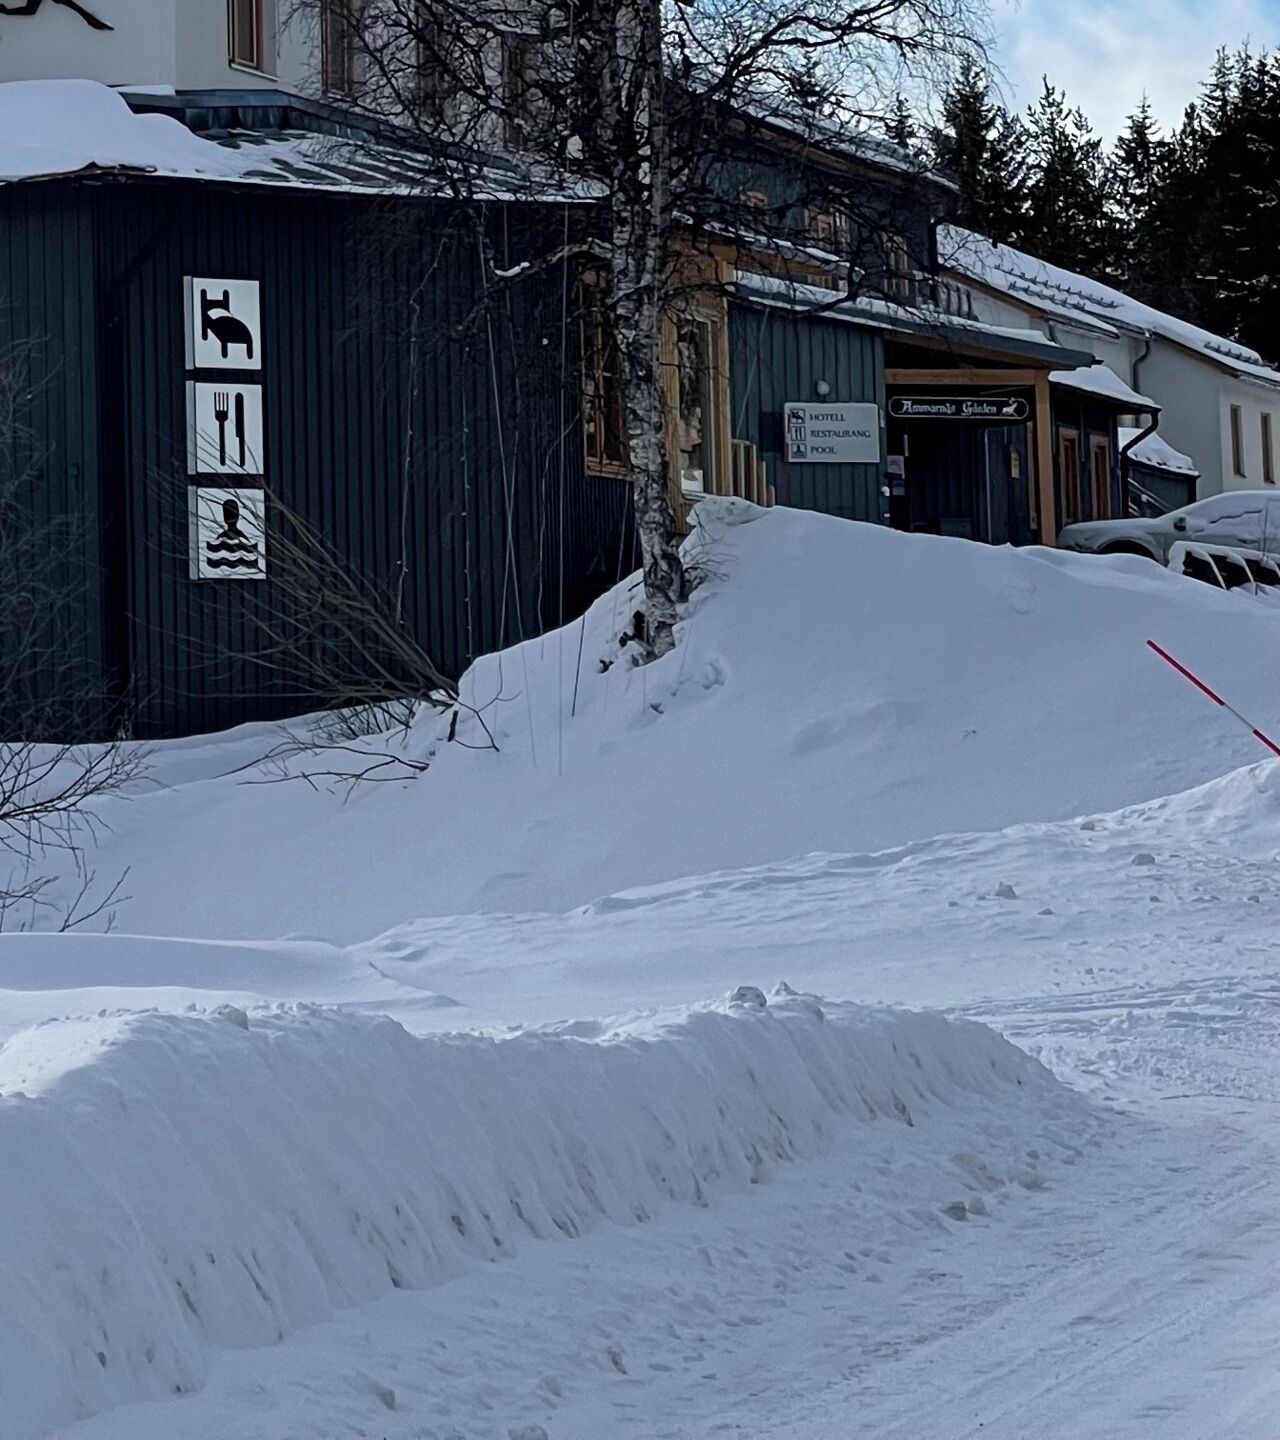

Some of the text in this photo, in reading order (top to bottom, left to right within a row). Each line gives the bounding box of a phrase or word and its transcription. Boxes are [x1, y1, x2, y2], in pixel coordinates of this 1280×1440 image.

[809, 413, 846, 422] HOTELL
[810, 429, 871, 439] RESTAURANG
[810, 446, 838, 455] POOL
